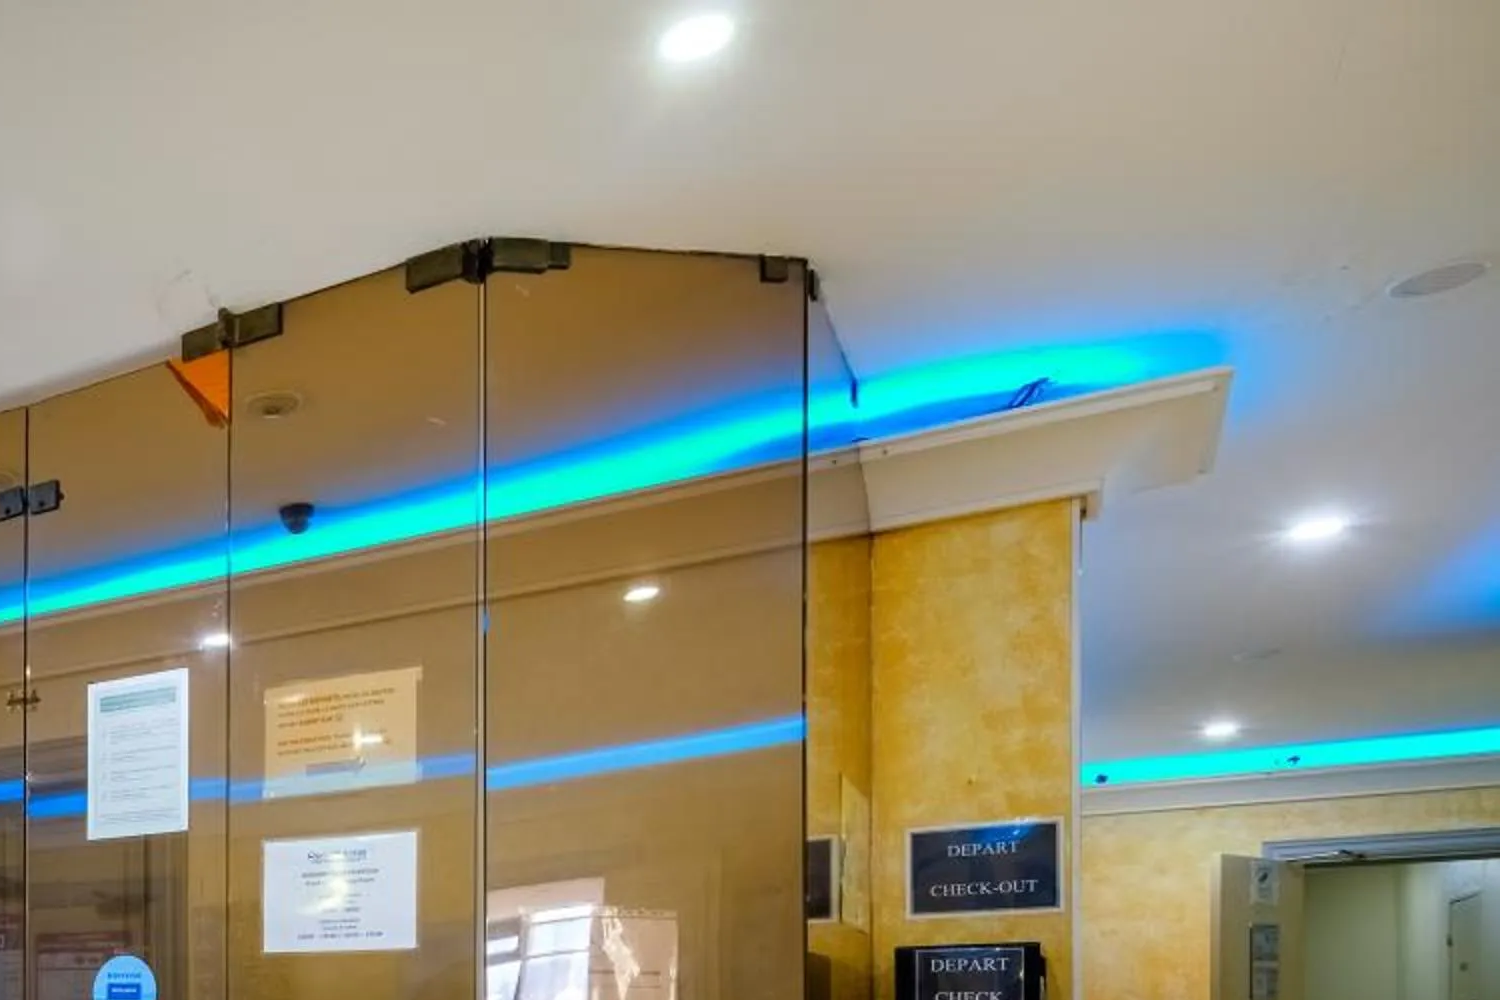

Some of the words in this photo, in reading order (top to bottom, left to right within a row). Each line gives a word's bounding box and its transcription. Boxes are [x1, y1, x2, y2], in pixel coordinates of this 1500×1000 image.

[947, 840, 1021, 858] DEPART
[929, 879, 1039, 898] CHECK-OUT
[930, 957, 1010, 973] DEPART
